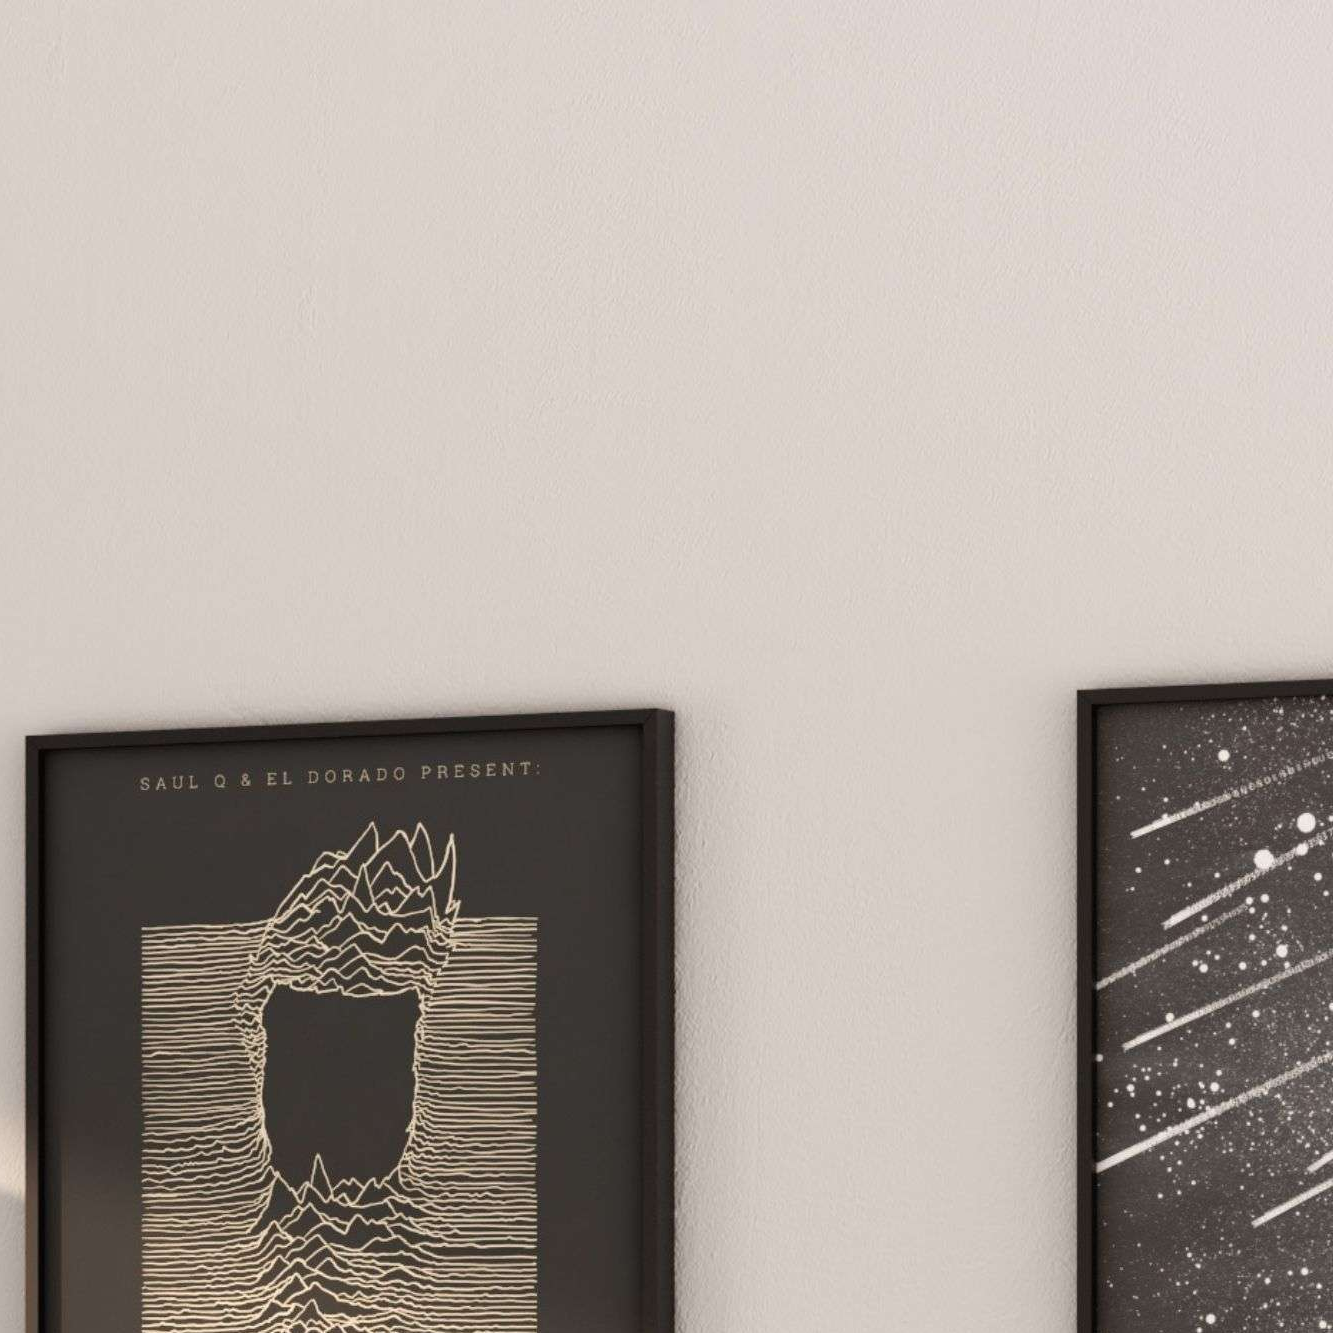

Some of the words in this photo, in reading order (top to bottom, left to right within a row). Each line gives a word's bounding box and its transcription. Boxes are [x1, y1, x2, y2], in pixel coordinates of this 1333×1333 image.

[139, 775, 199, 792] SAUL
[214, 773, 228, 789] Q
[240, 772, 252, 788] &
[266, 770, 293, 787] EL
[308, 766, 407, 785] DORADO
[420, 761, 541, 780] PRESENT:
